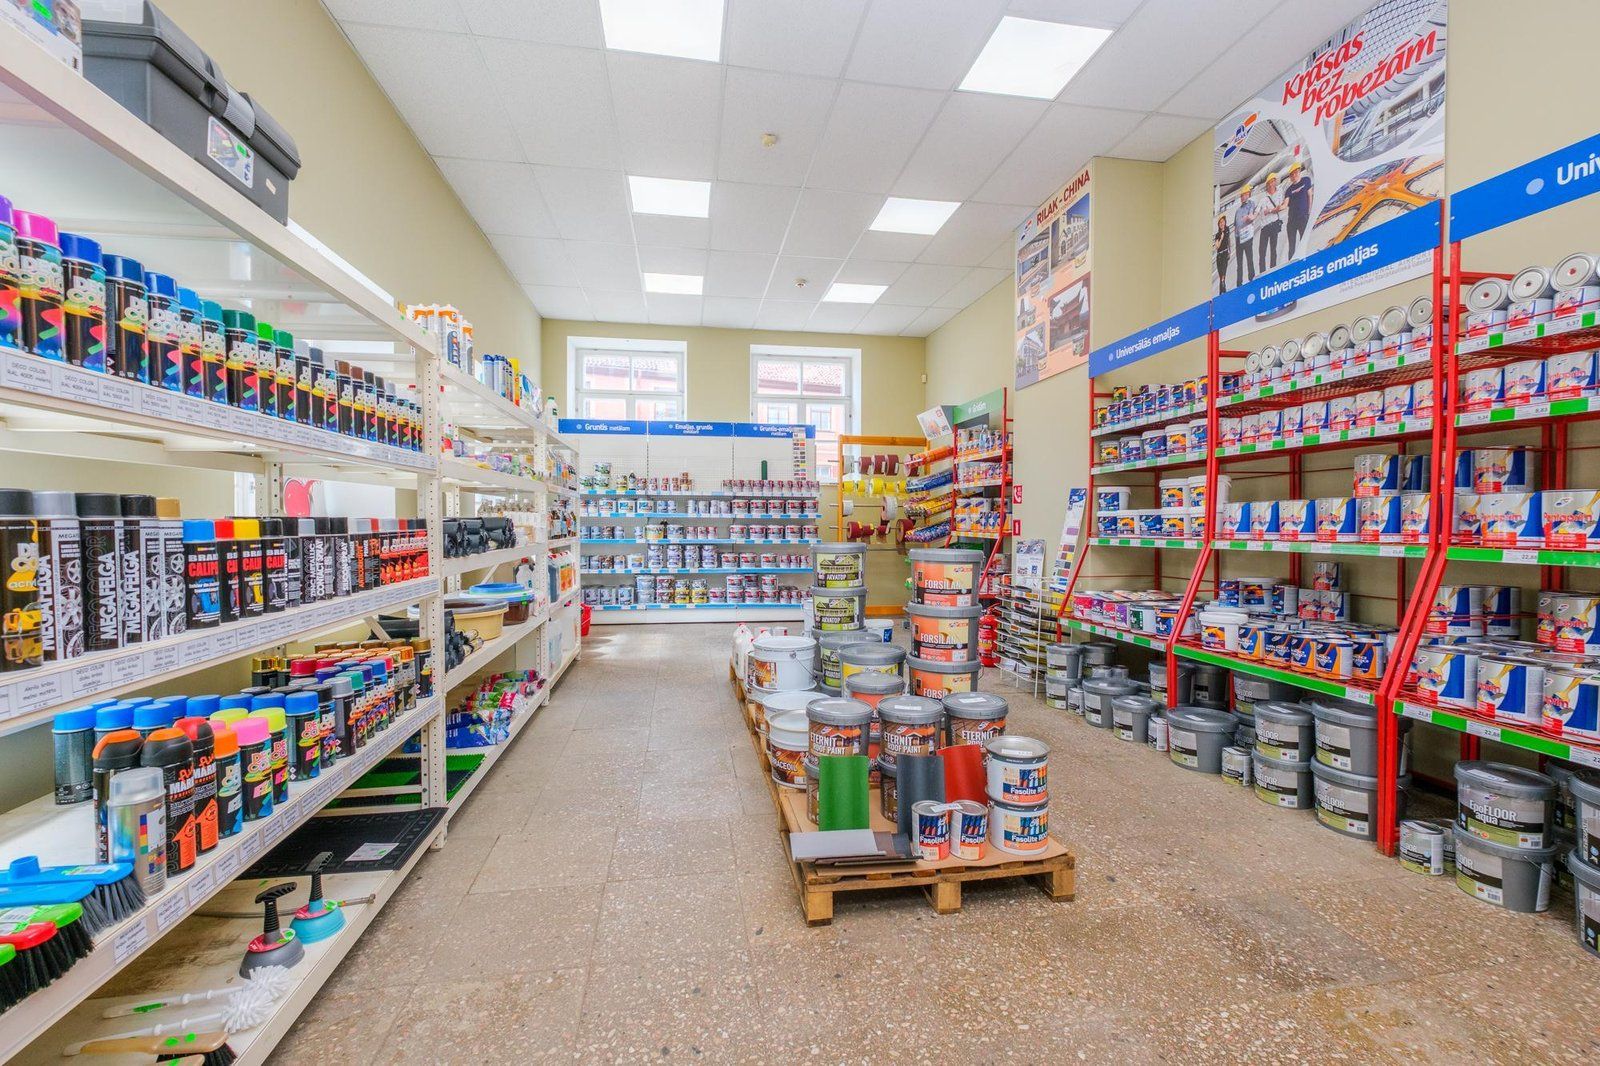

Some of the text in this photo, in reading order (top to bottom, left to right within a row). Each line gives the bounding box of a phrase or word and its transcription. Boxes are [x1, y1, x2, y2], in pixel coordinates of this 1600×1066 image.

[1281, 31, 1366, 107] Krāsas
[1312, 29, 1436, 127] robežām
[1301, 77, 1345, 114] bez
[1037, 196, 1059, 226] RILAK
[1063, 169, 1091, 203] CHINA
[1260, 264, 1325, 300] Universālās
[1325, 243, 1379, 276] emaljas
[1115, 324, 1181, 360] Universālās emaljas
[585, 423, 608, 431] Gruntis
[124, 550, 141, 634] MEGAFELGA
[925, 579, 962, 590] FORSILAN
[98, 551, 119, 641] MEGAFELGA
[920, 632, 956, 645] FORSILAN
[810, 731, 837, 748] ETERNIT
[884, 731, 912, 748] ETERNIT
[961, 730, 994, 744] ETERNIT
[826, 746, 846, 756] PAINT
[902, 745, 922, 755] PAINT
[1010, 787, 1036, 795] Fasolite
[1469, 799, 1517, 822] EpoFLOOR
[1475, 811, 1498, 827] aqua
[1011, 834, 1038, 843] Fasolite
